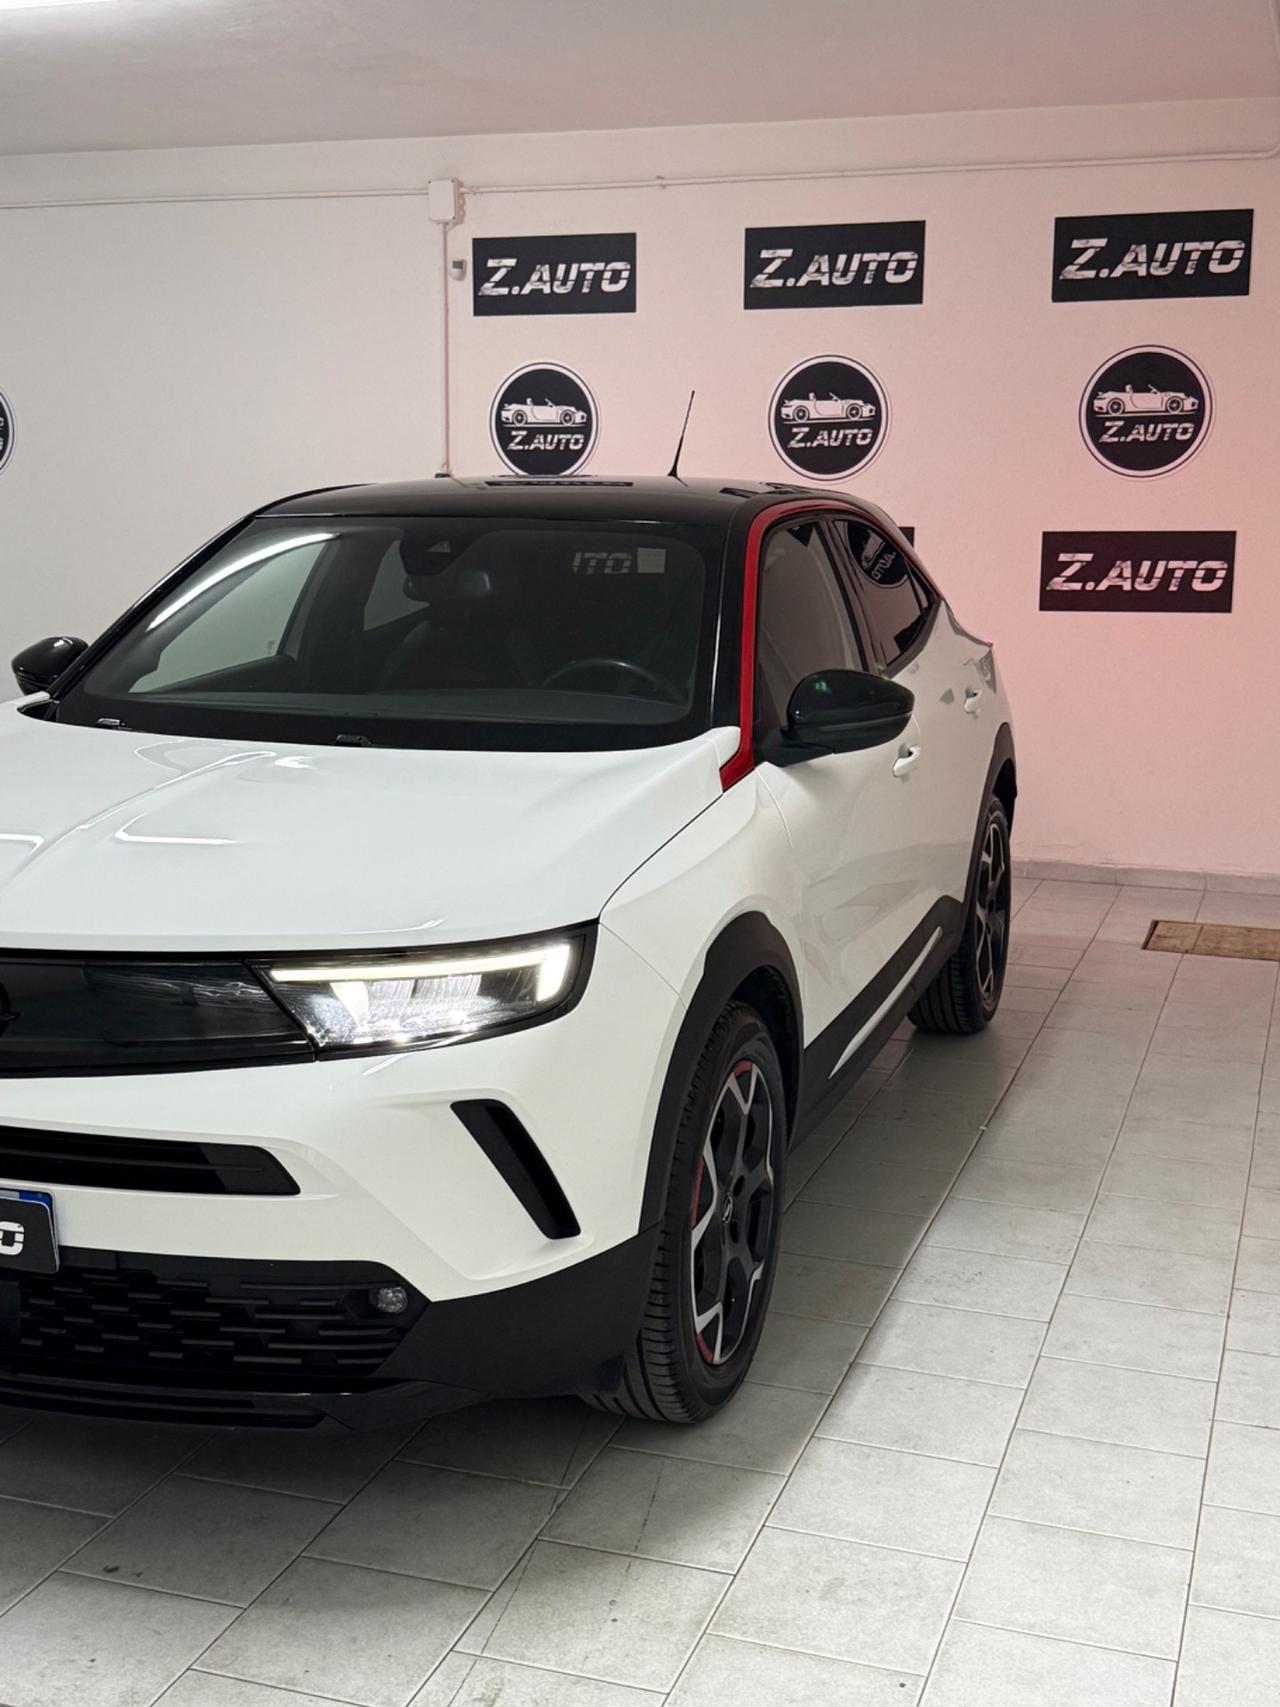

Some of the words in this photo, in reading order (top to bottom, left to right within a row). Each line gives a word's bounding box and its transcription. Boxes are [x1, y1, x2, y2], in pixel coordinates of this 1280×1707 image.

[479, 258, 630, 296] Z.AUTO
[750, 249, 918, 287] Z.AUTO
[1059, 238, 1245, 279] Z.AUTO
[507, 430, 585, 451] Z.AUTO
[786, 427, 873, 449] Z.AUTO
[1100, 421, 1195, 443] Z.AUTO
[1046, 552, 1228, 592] Z.AUTO
